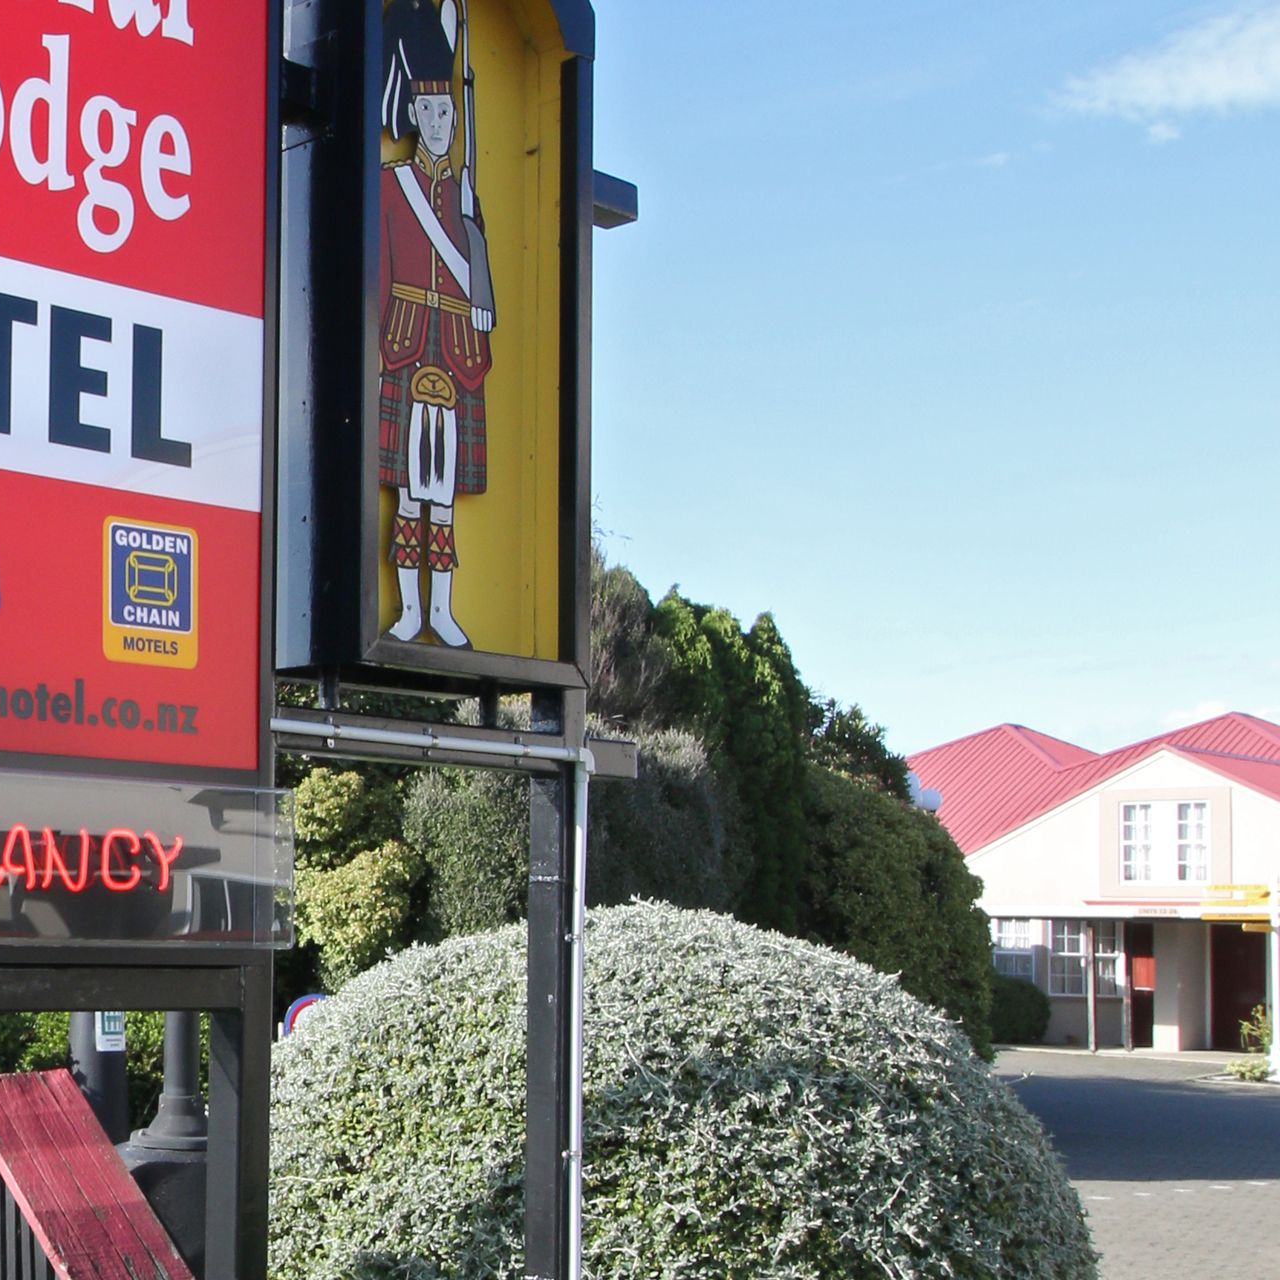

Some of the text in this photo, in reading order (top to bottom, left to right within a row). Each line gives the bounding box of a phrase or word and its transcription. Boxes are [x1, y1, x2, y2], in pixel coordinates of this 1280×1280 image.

[115, 529, 188, 555] GOLDEN
[123, 605, 180, 627] CHAIN
[123, 636, 179, 656] MOTELS
